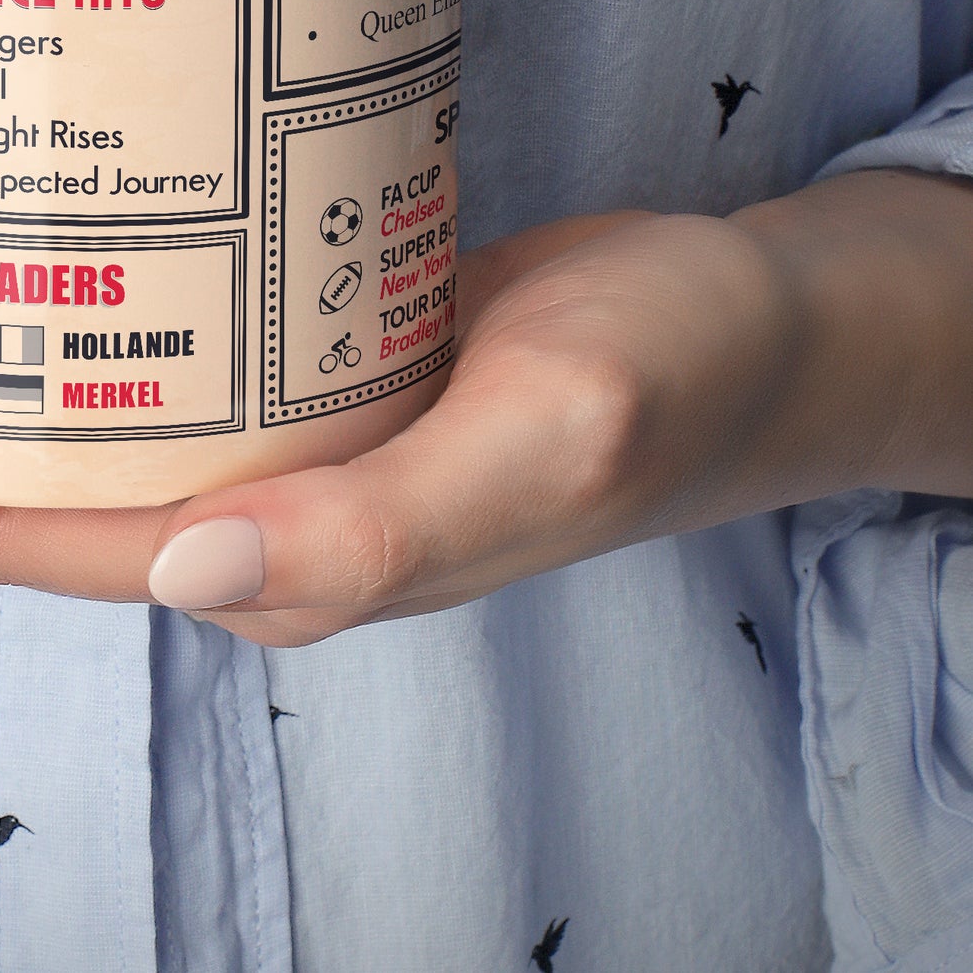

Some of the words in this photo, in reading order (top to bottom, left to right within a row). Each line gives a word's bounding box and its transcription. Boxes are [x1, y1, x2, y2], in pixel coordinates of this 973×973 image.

[360, 1, 427, 43] Queen
[51, 119, 124, 150] Rises
[110, 168, 224, 198] Journey
[381, 183, 404, 210] FA
[407, 164, 441, 199] CUP
[381, 195, 445, 237] Chelsea
[380, 229, 436, 273] SUPER
[380, 269, 420, 300] New
[423, 243, 452, 281] York
[379, 293, 429, 333] TOUR
[432, 278, 450, 310] DE
[63, 329, 195, 360] HOLLANDE
[379, 315, 443, 360] Bradley
[63, 381, 164, 409] MERKEL
